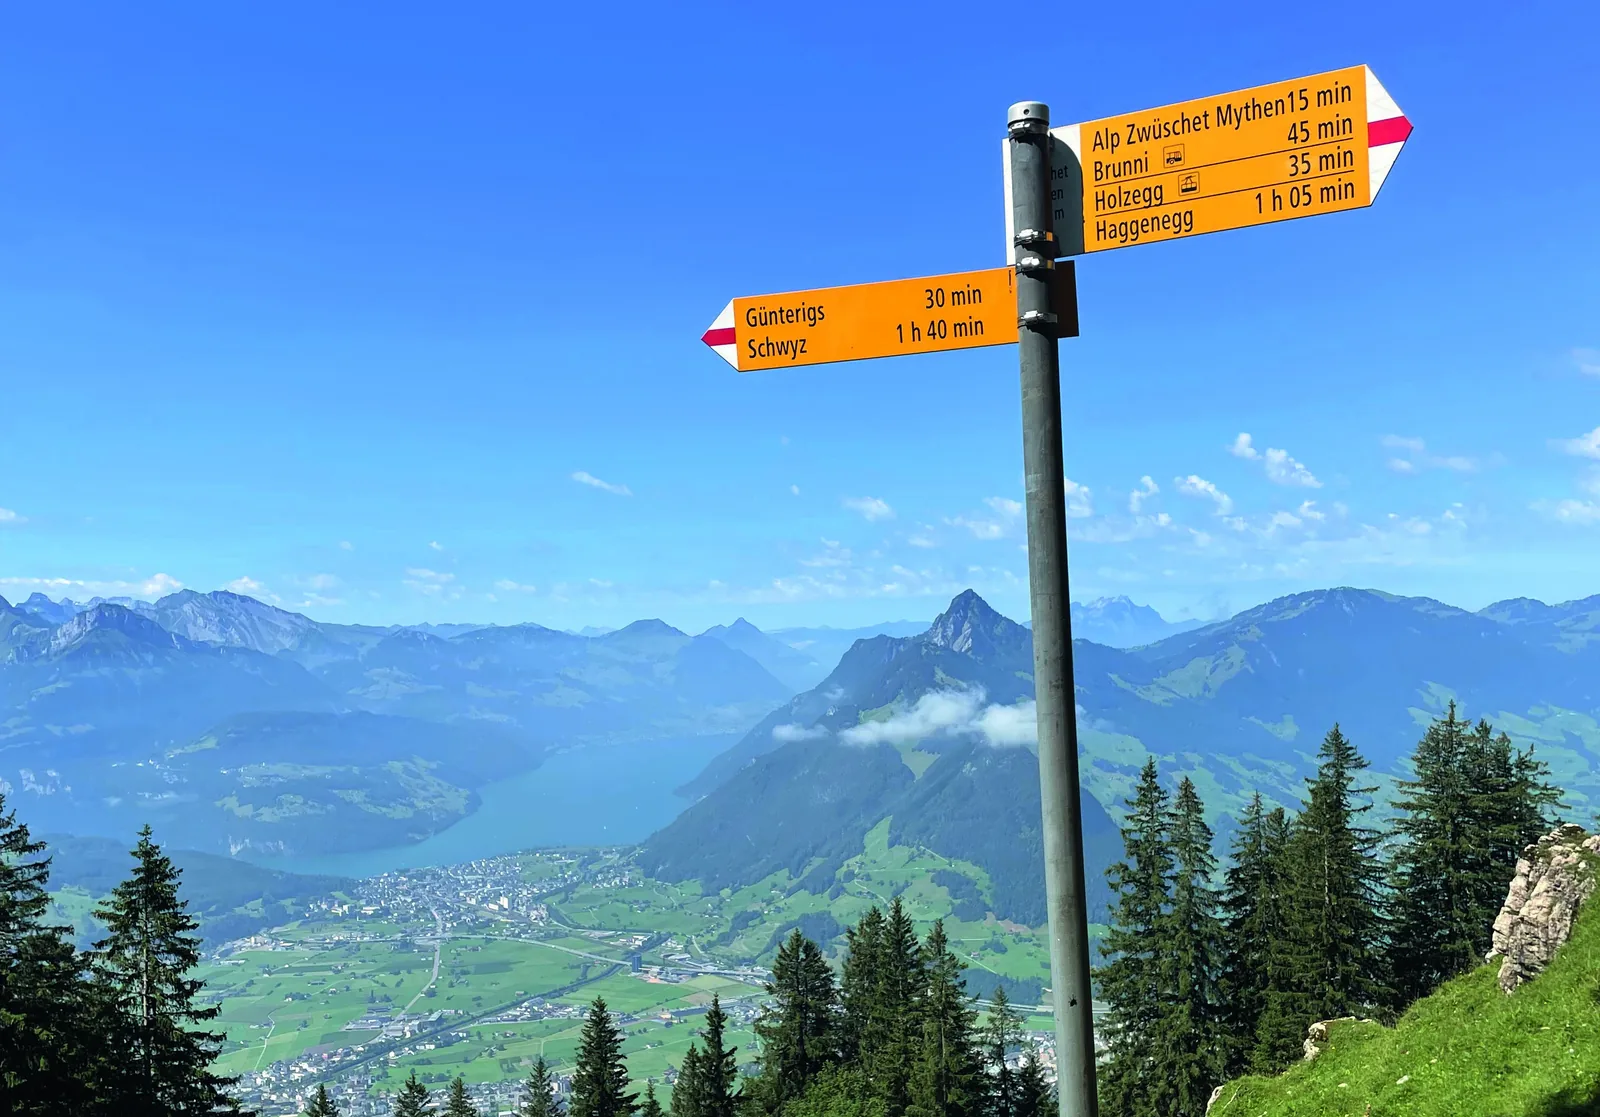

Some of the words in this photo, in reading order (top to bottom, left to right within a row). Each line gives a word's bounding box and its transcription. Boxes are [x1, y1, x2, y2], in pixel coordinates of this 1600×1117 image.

[1092, 128, 1120, 155] Alp
[1126, 110, 1210, 145] Zwüschet
[1216, 97, 1285, 131] Mythen
[1287, 88, 1309, 113] 15
[1316, 80, 1352, 108] min
[1094, 150, 1149, 182] Brunni
[1287, 120, 1310, 145] 45
[1318, 113, 1353, 140] min
[1095, 181, 1164, 212] Holzegg
[1289, 151, 1311, 177] 35
[1319, 145, 1354, 172] min
[1096, 208, 1194, 244] Haggenegg
[1255, 192, 1263, 214] 1
[1272, 188, 1283, 212] h
[1289, 183, 1312, 209] 05
[1320, 177, 1355, 204] min
[746, 301, 825, 328] Günterigs
[925, 287, 945, 309] 30
[951, 283, 982, 307] min
[747, 336, 808, 360] Schwyz
[896, 323, 903, 344] 1
[911, 321, 921, 342] h
[927, 319, 947, 340] 40
[953, 315, 984, 338] min
